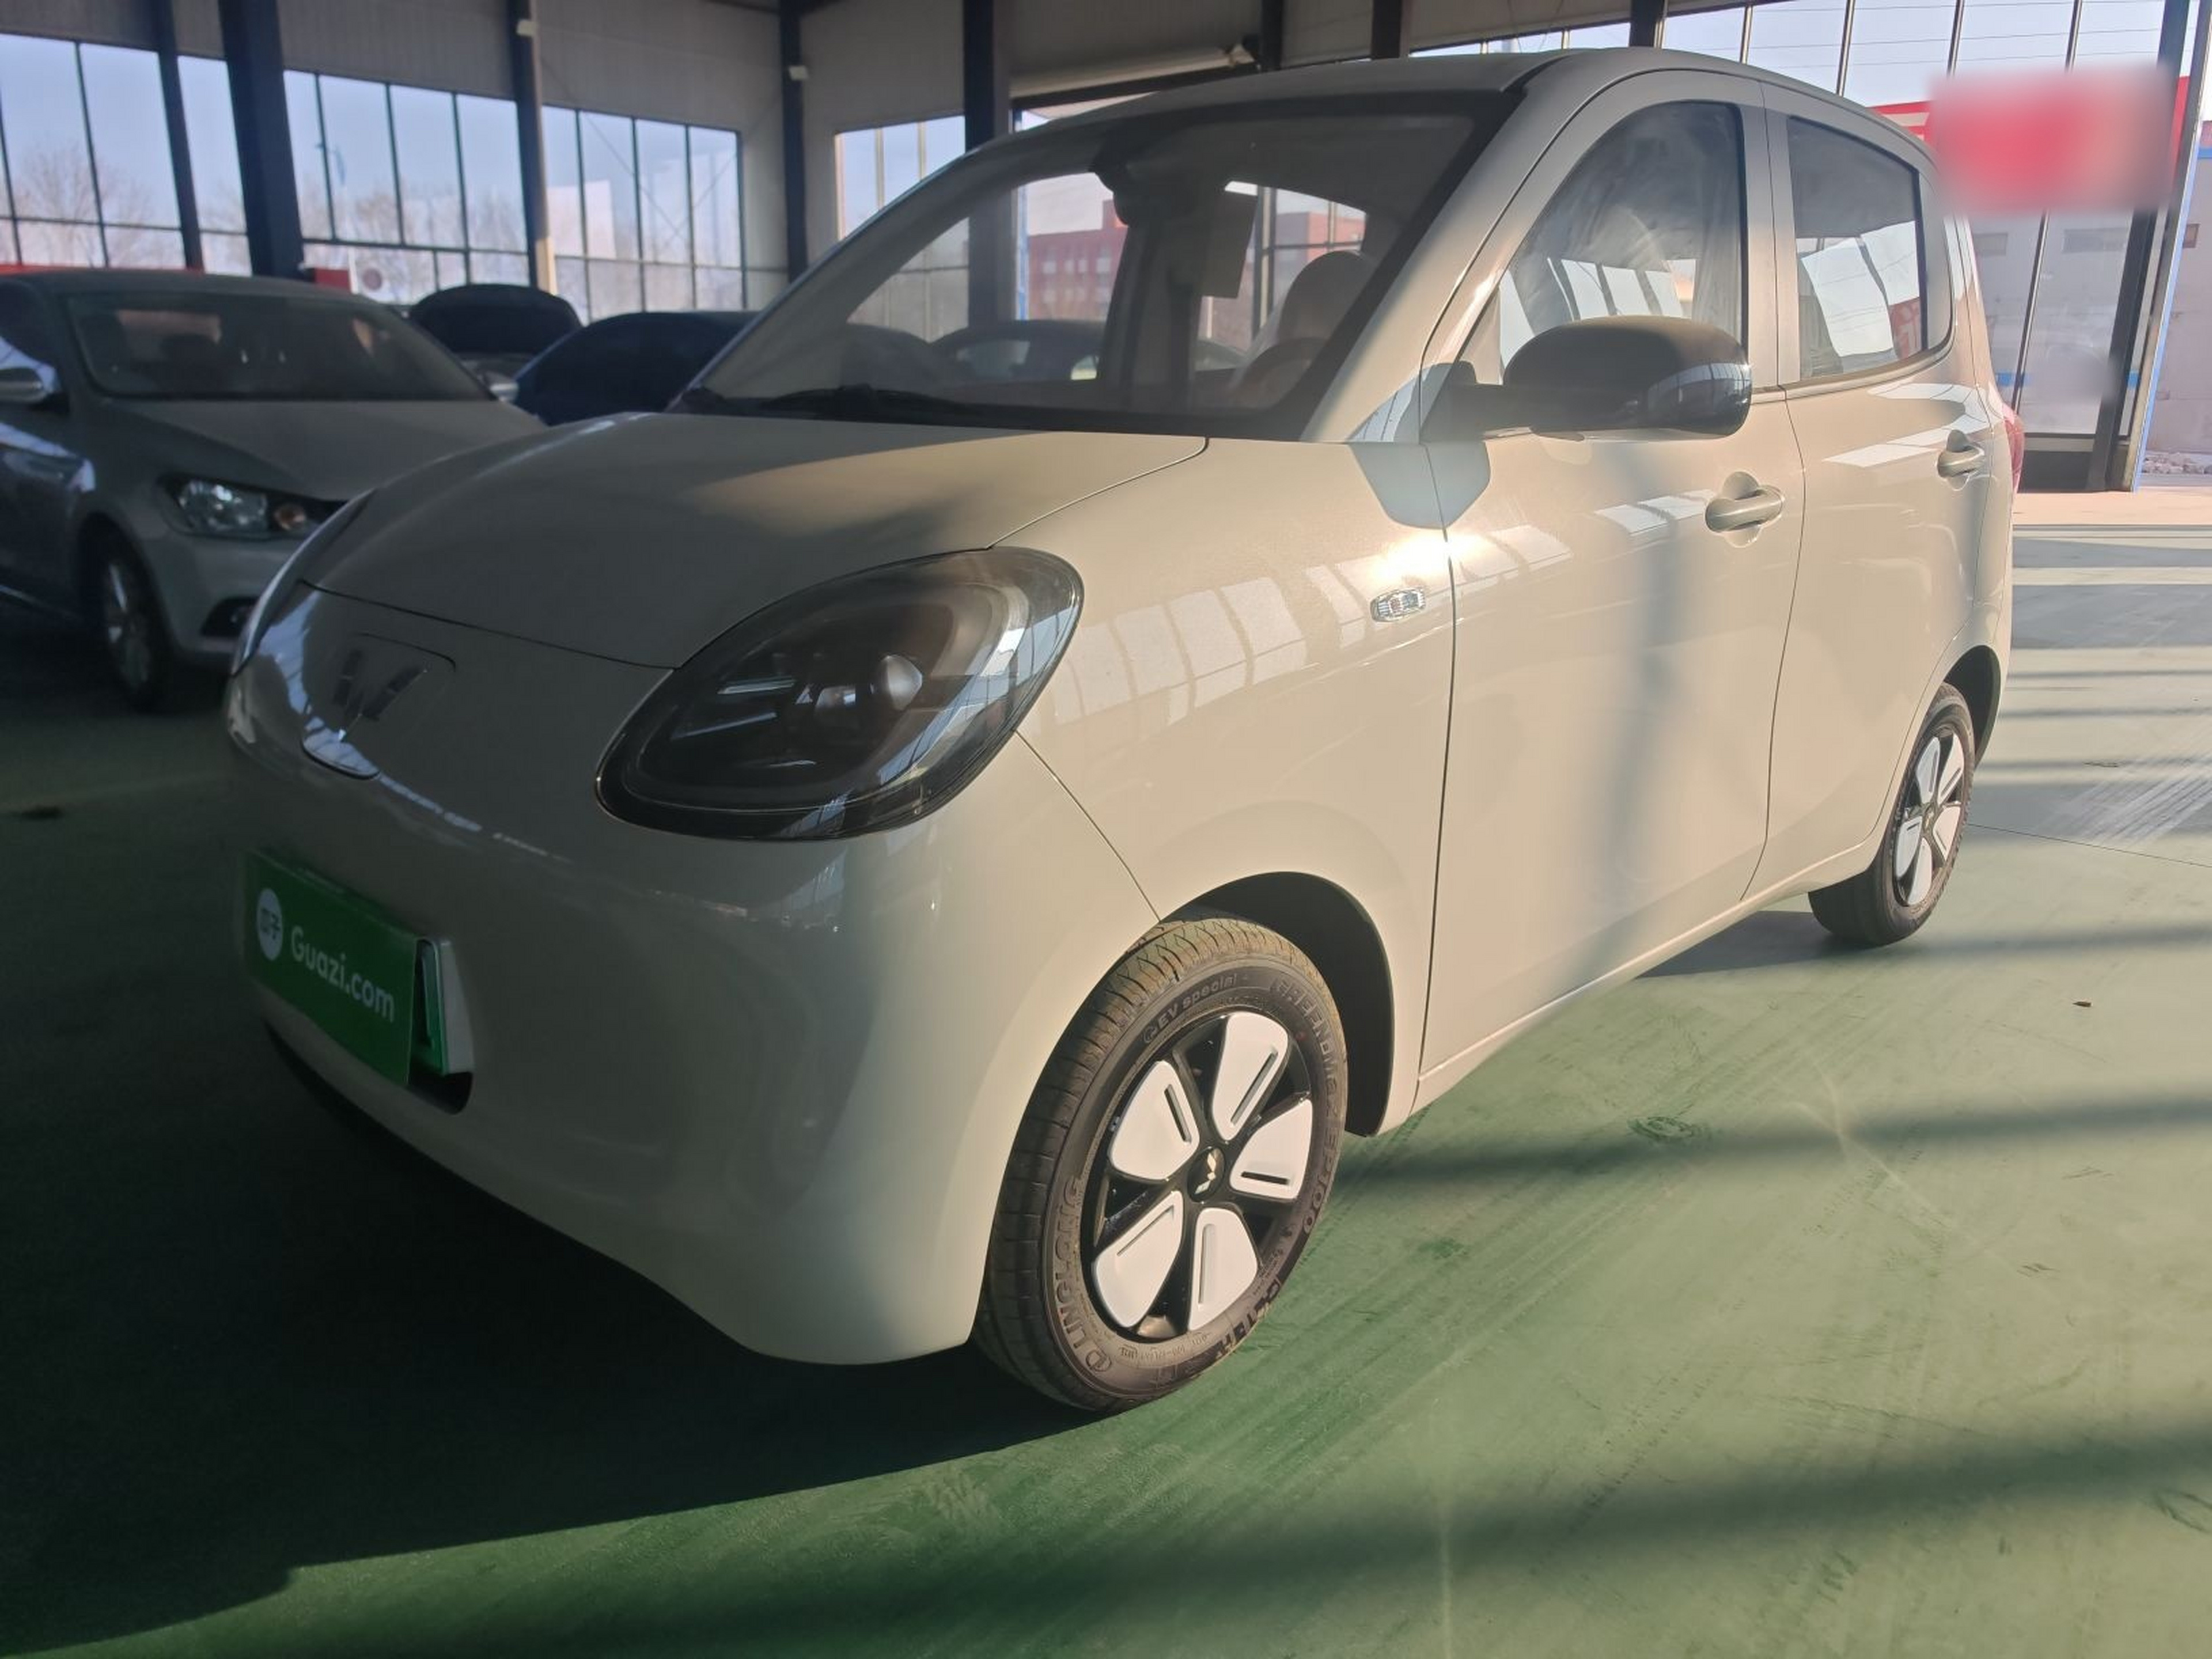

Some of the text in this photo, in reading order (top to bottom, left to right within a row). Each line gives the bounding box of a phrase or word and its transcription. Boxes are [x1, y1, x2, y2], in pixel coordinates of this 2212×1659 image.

[291, 925, 395, 1022] Guazi.com
[1158, 973, 1238, 1029] EV special
[1055, 1175, 1086, 1349] LINGLONG
